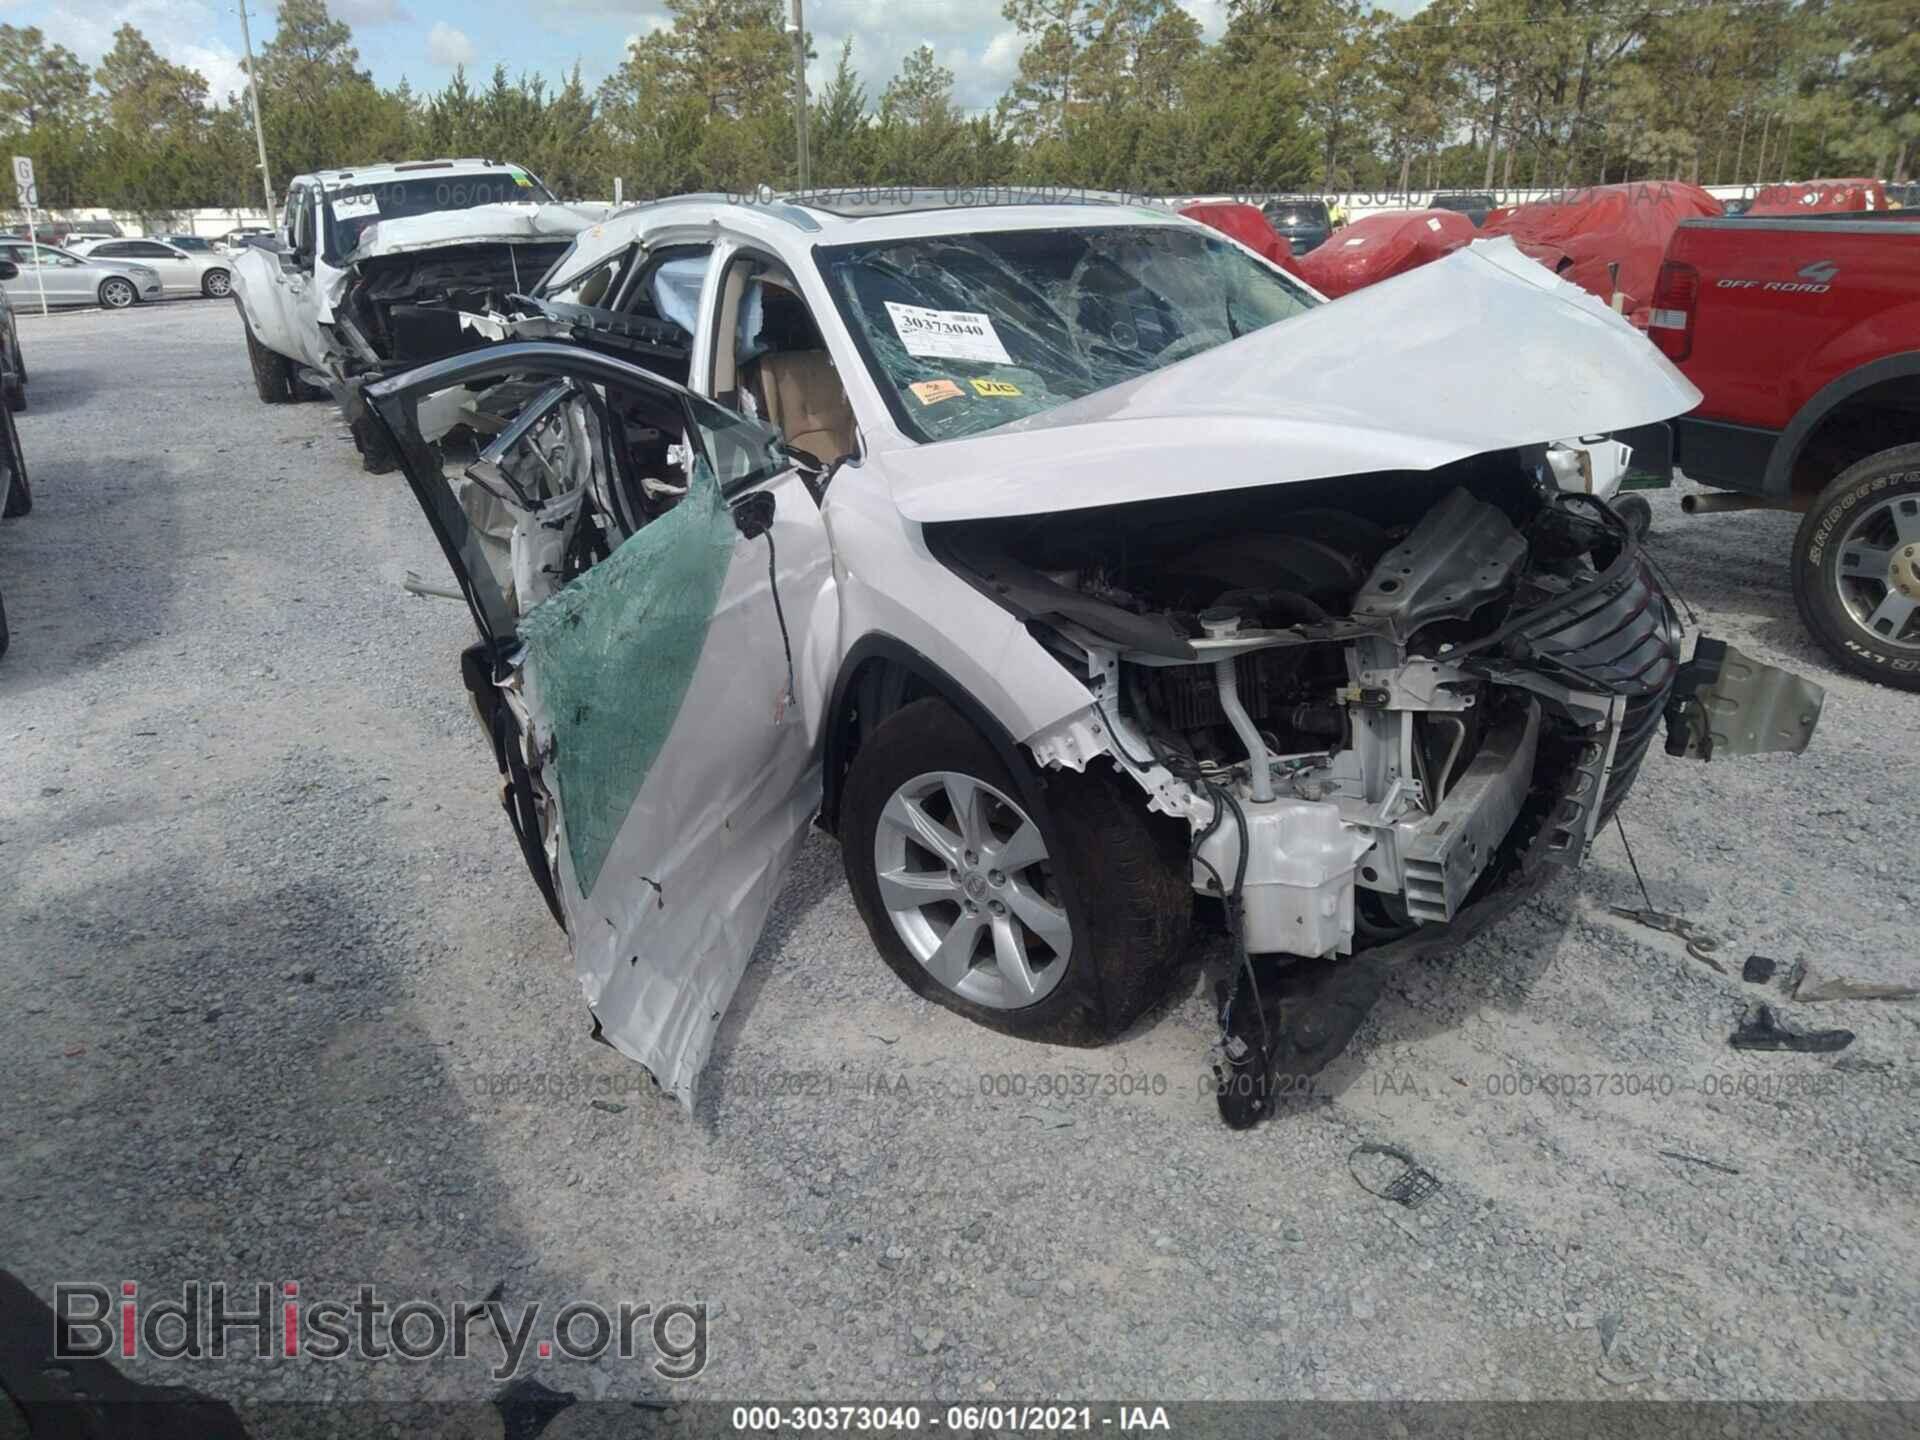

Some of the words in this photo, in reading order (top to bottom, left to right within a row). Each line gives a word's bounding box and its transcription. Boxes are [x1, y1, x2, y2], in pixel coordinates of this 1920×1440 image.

[18, 160, 30, 178] G
[1716, 279, 1759, 289] OFF
[1763, 281, 1832, 294] ROAD
[901, 315, 984, 337] 30373040
